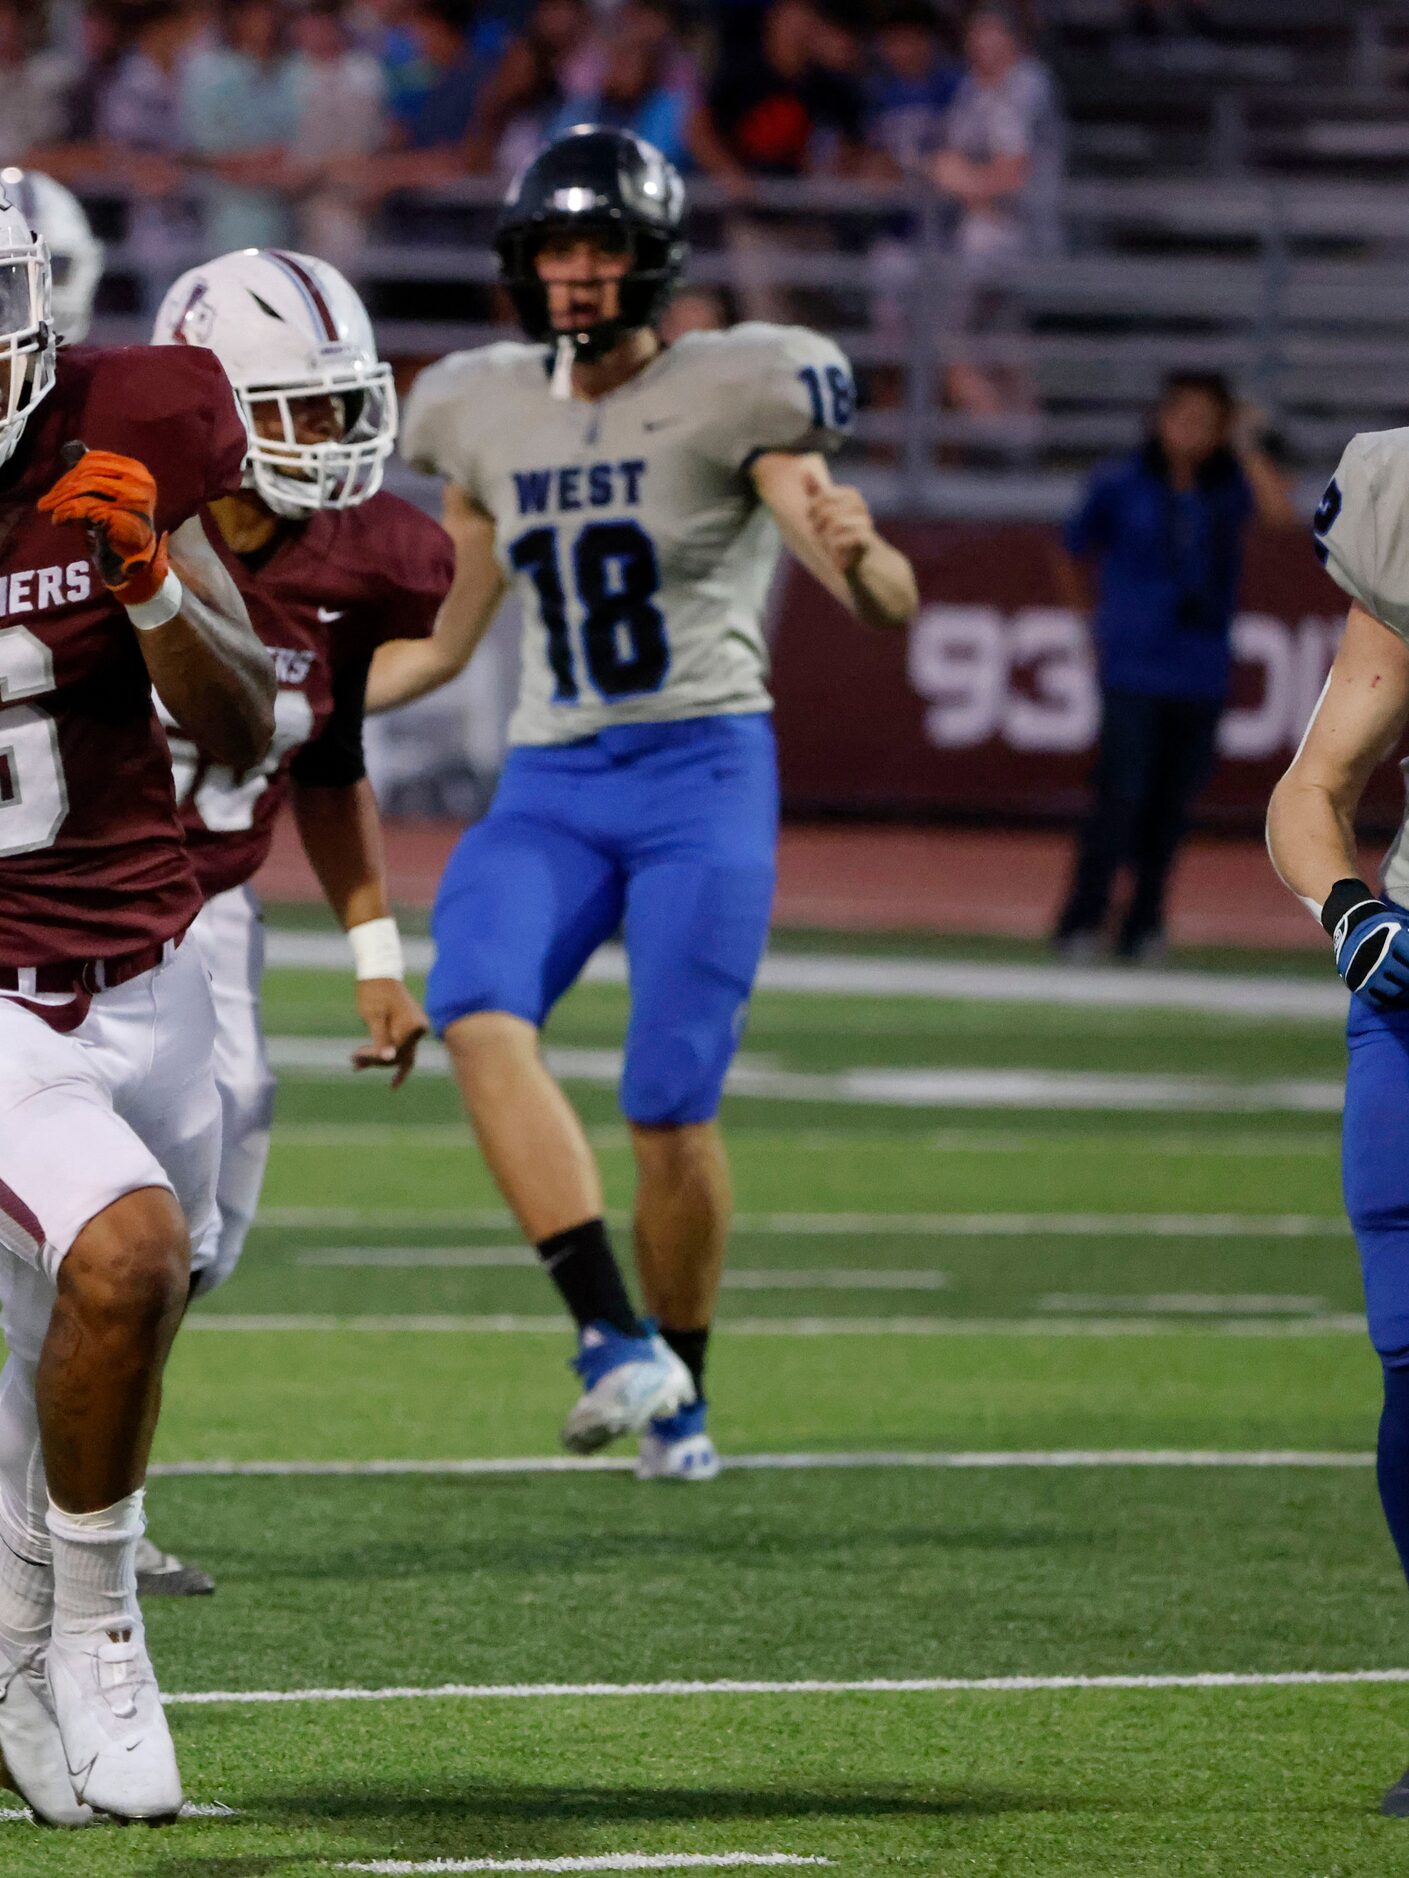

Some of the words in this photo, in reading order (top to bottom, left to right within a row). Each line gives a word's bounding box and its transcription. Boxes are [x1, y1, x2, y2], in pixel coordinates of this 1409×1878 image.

[797, 365, 856, 429] 18
[512, 459, 648, 515] WEST
[508, 519, 672, 706] 18
